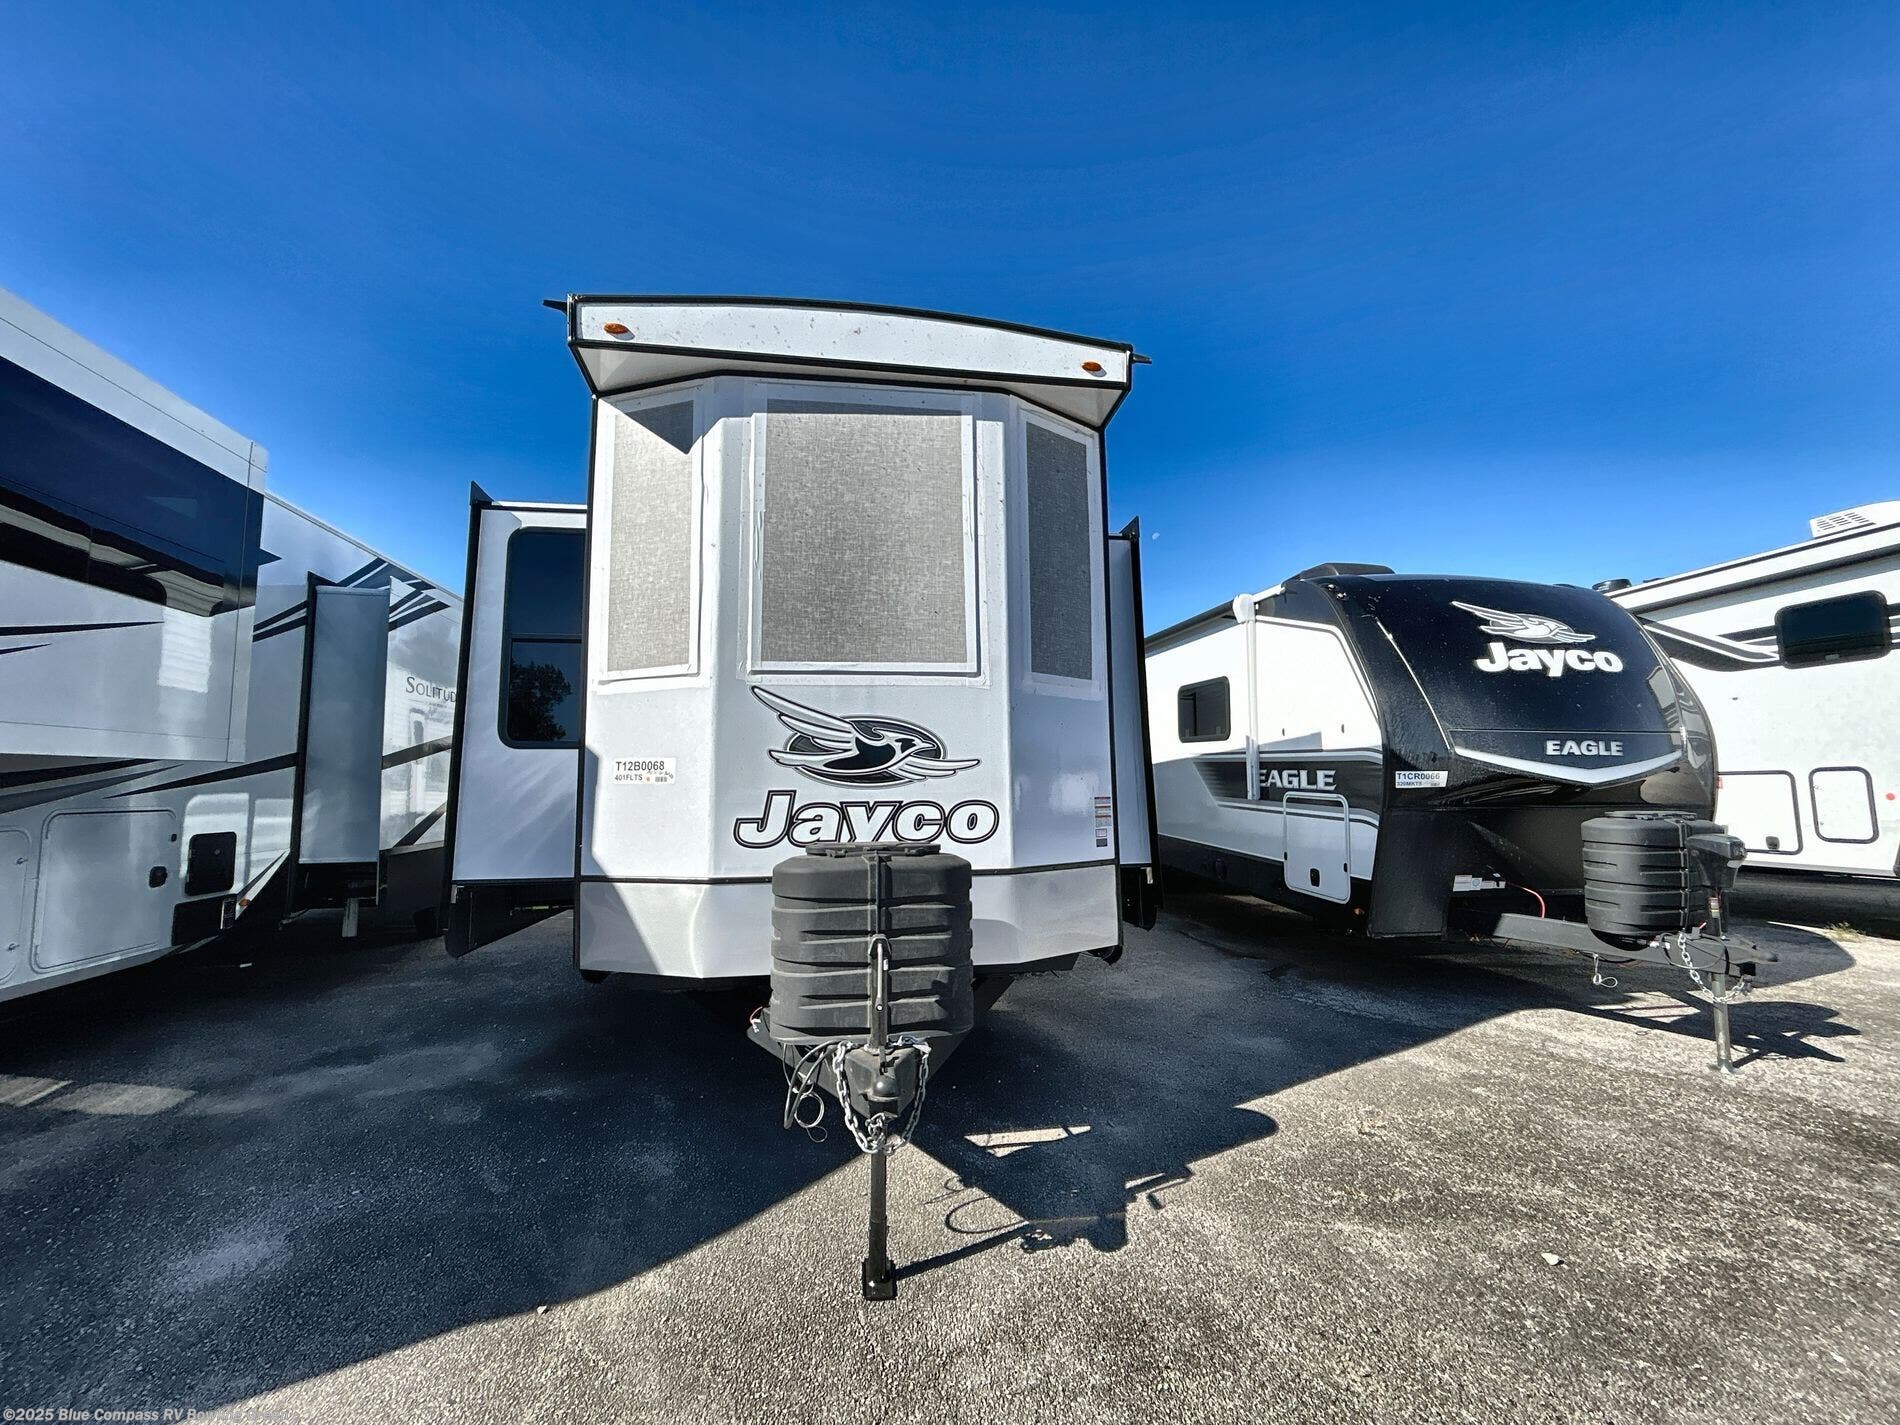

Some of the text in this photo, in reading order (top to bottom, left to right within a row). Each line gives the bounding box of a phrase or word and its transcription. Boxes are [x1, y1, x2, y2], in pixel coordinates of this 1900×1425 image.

[1475, 642, 1623, 677] Jayco
[406, 676, 457, 702] SOLITUD
[1546, 740, 1624, 756] EAGLE
[616, 760, 665, 771] T12B0068
[733, 789, 1000, 849] Jayco
